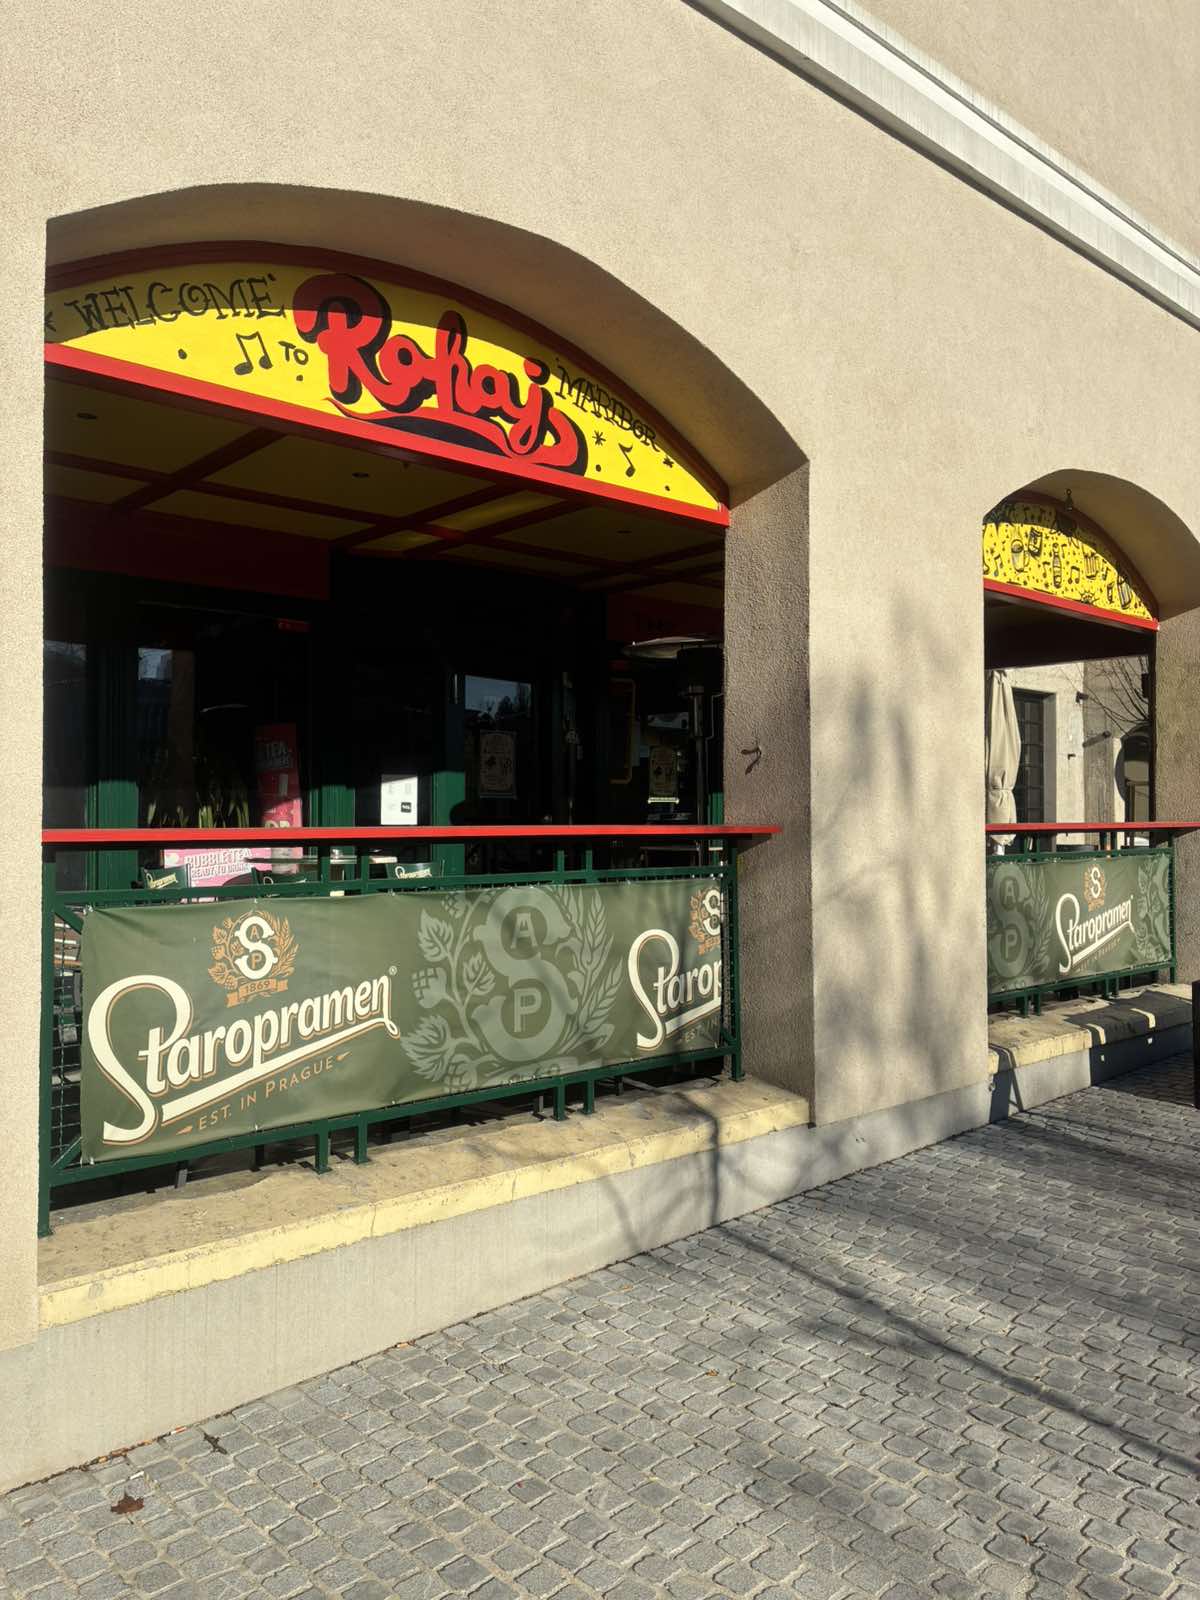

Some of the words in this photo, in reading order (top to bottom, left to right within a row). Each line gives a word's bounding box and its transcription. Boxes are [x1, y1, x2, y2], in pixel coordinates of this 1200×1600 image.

[64, 277, 287, 334] WELCOME
[278, 340, 309, 365] TO
[234, 915, 279, 980] S
[511, 912, 538, 950] A
[1056, 893, 1137, 973] Staropramen
[244, 979, 271, 994] 1869
[513, 987, 542, 1033] P
[88, 974, 400, 1145] Staropramen
[240, 1090, 257, 1110] IN
[265, 1055, 334, 1099] PRAGUE
